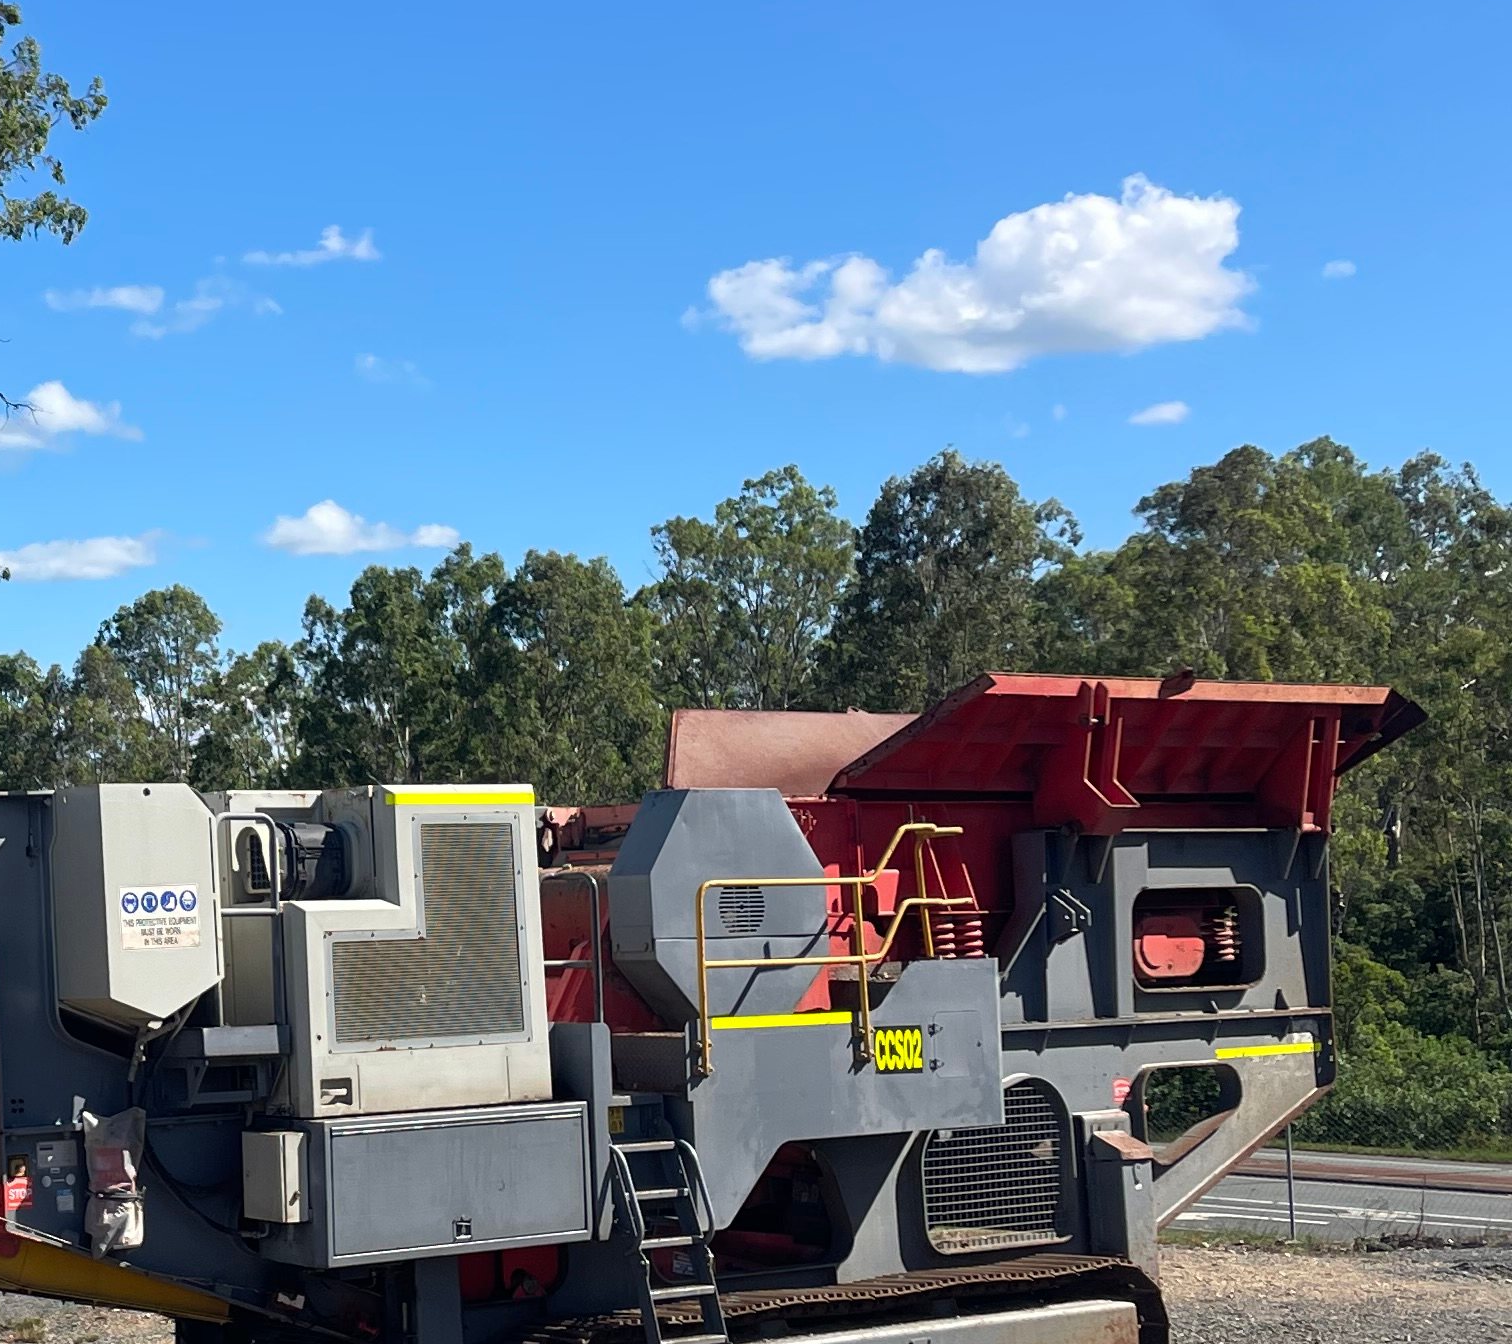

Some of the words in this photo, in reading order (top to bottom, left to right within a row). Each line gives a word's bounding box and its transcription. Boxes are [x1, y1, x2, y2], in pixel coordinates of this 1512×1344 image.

[123, 918, 134, 927] THIS
[168, 916, 196, 925] EQUIPMENT
[140, 928, 155, 936] MUST
[156, 927, 164, 935] BE
[165, 927, 181, 935] WORN
[164, 936, 179, 945] AREA
[7, 1187, 33, 1201] STOP
